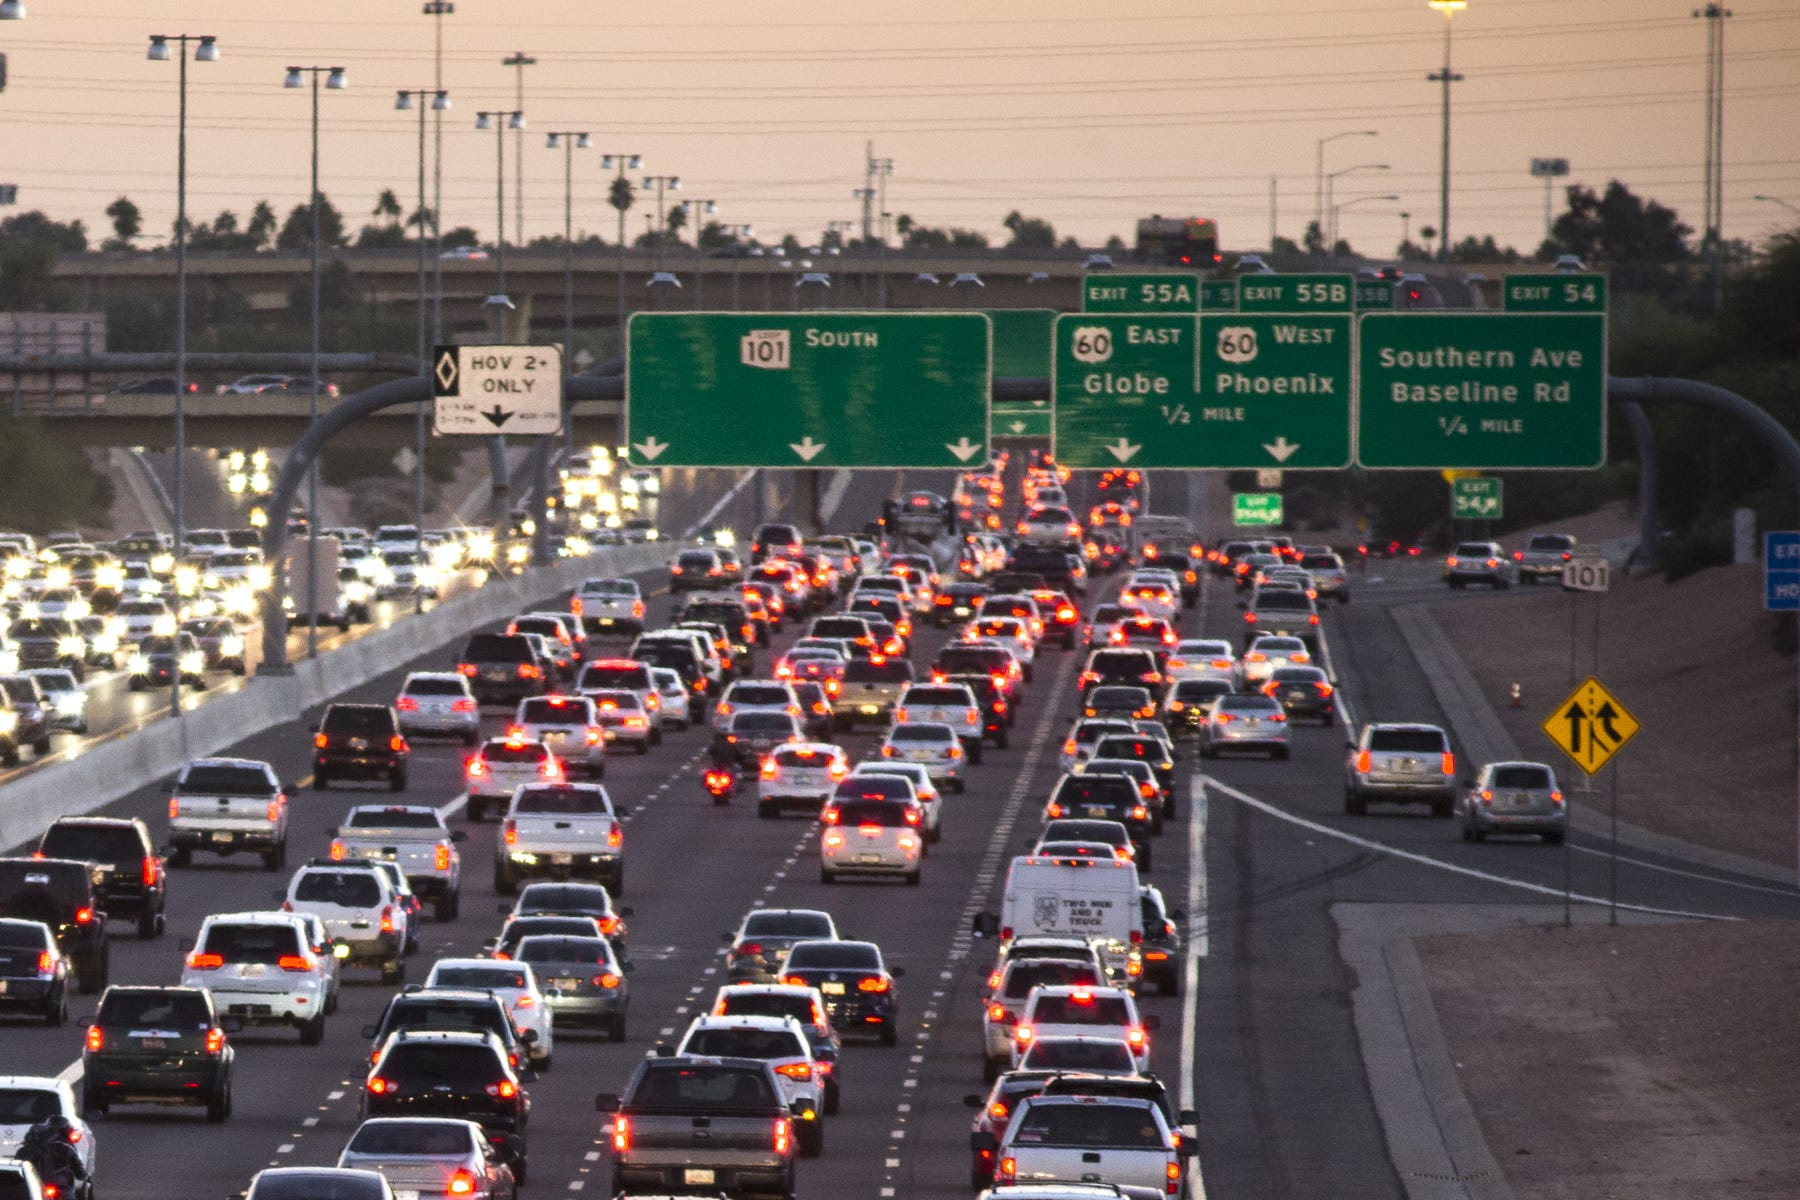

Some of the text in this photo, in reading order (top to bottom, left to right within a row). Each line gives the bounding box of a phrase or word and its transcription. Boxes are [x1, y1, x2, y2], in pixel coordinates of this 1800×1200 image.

[1090, 287, 1128, 300] EXIT
[1141, 284, 1191, 302] 55A
[1245, 287, 1283, 300] EXIT
[1296, 284, 1347, 302] 55B
[1512, 284, 1597, 302] EXIT 54
[805, 328, 878, 347] SOUTH
[1127, 325, 1182, 344] EAST
[1272, 325, 1334, 344] WEST
[748, 340, 785, 362] 101
[1077, 334, 1111, 355] 60
[1221, 334, 1255, 355] 60
[471, 355, 548, 370] HOV 2+
[1379, 347, 1582, 367] Southern Ave
[483, 378, 536, 393] ONLY
[1084, 373, 1169, 394] Globe
[1216, 372, 1335, 394] Phoenix
[1392, 381, 1570, 402] Baseline Rd
[1202, 407, 1245, 421] MILE
[1481, 419, 1524, 433] MILE
[1569, 566, 1605, 587] 101
